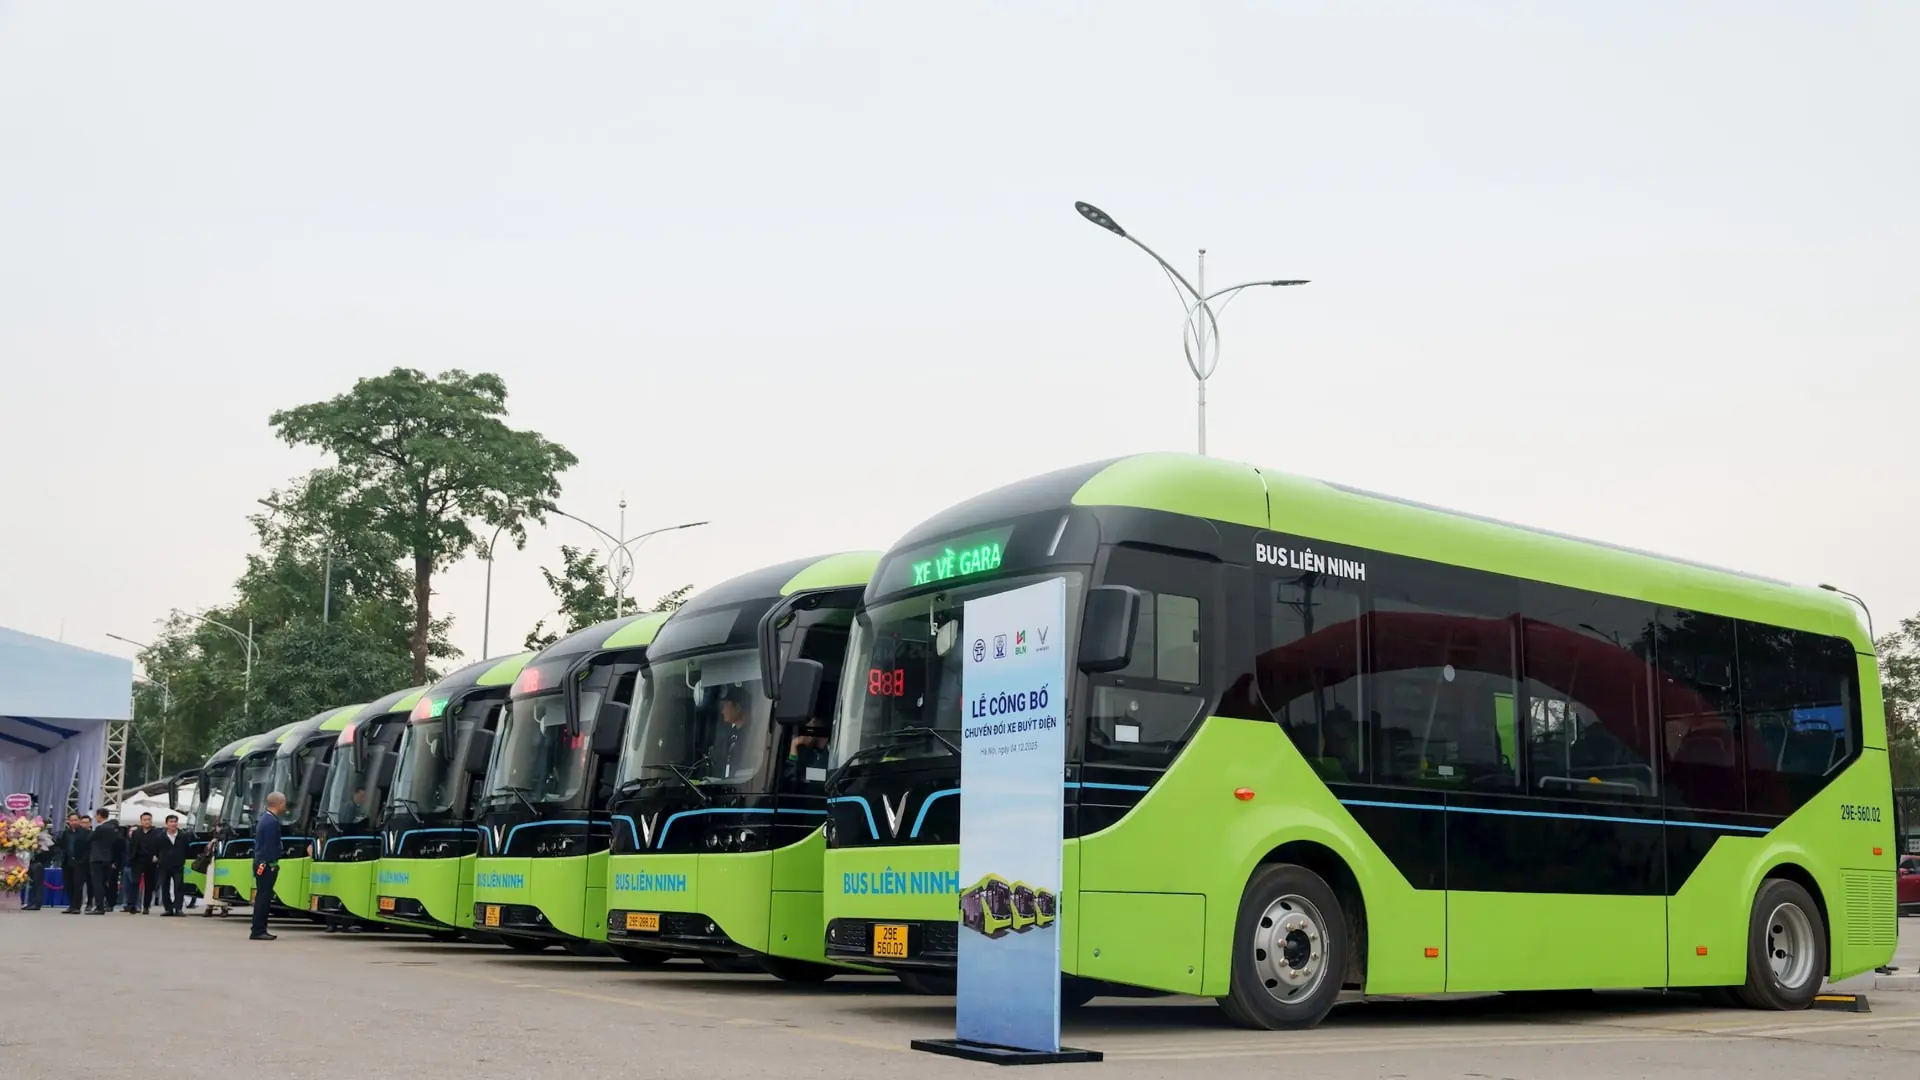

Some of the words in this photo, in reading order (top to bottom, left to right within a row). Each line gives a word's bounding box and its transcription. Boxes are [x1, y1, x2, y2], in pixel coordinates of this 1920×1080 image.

[912, 561, 931, 586] XE
[936, 547, 955, 580] VỀ
[960, 543, 1000, 575] GARA
[1256, 543, 1288, 567] BUS
[1290, 548, 1325, 573] LIÊN
[1328, 556, 1365, 581] NINH
[972, 692, 986, 718] LỄ
[989, 691, 1025, 716] CÔNG
[1029, 683, 1049, 710] BỐ
[1007, 722, 1016, 734] XE
[1017, 717, 1037, 732] BUÝT
[1038, 715, 1057, 731] ĐIỆN
[1841, 804, 1881, 822] 29E-560.02
[502, 873, 524, 888] NINH
[616, 874, 630, 890] BUS
[631, 868, 653, 891] LIÊN
[655, 874, 686, 892] NINH
[843, 872, 868, 894] BUS
[871, 866, 906, 895] LIÊN
[910, 871, 959, 894] NINH
[883, 927, 898, 940] 29E
[877, 942, 903, 955] 560.02
